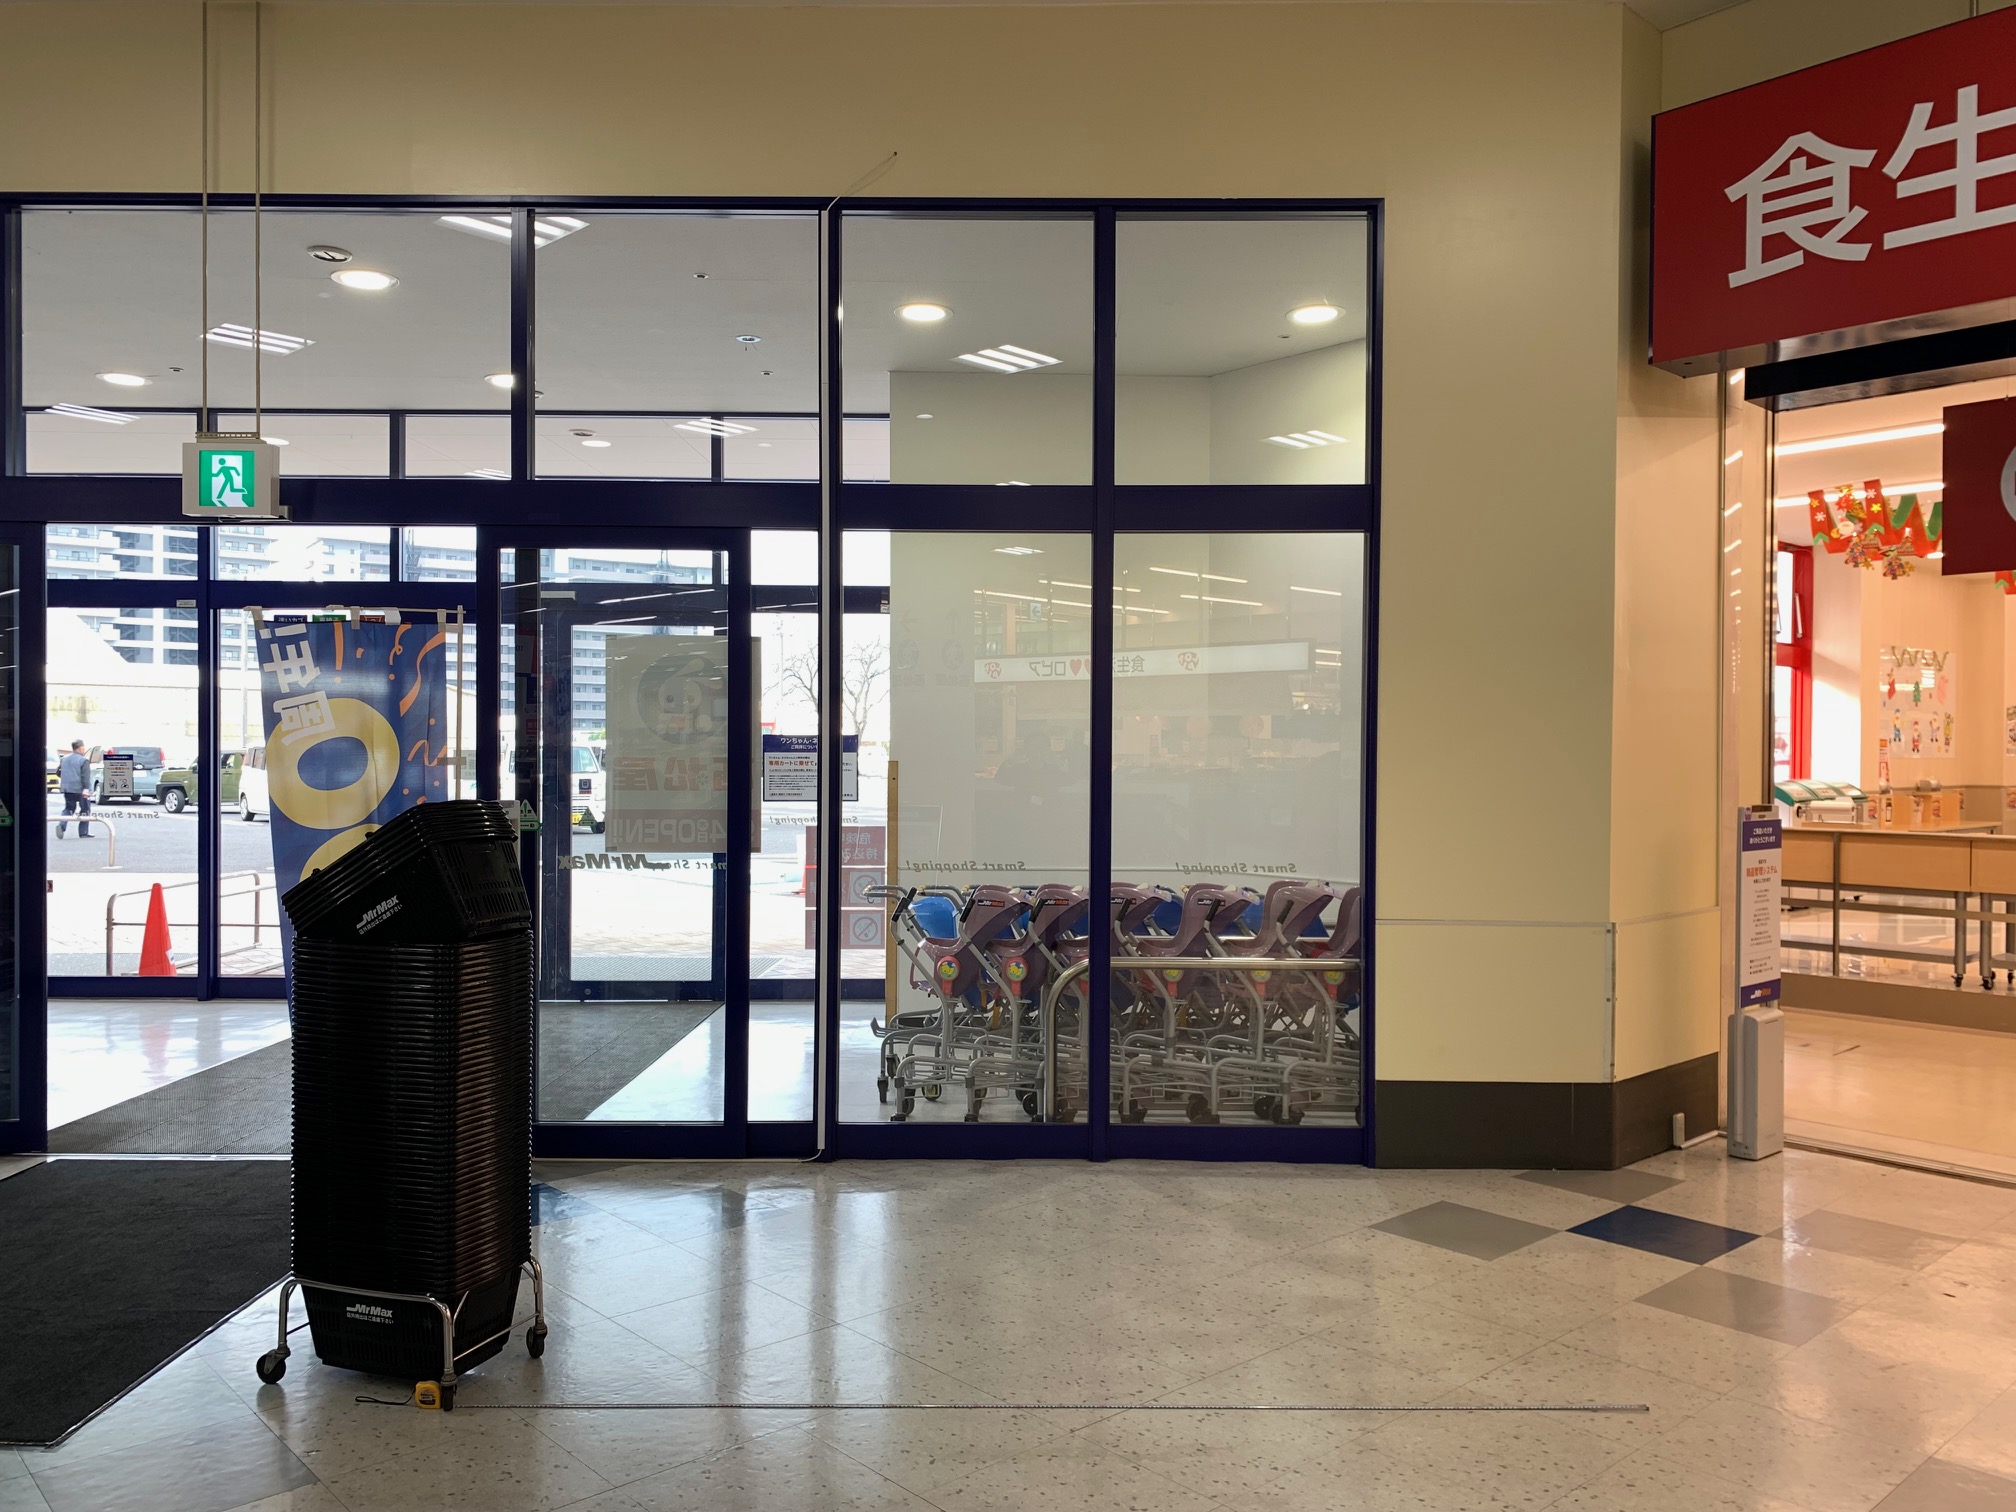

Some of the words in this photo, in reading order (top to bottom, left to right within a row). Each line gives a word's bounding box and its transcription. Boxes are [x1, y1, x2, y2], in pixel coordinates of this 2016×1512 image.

[1724, 84, 2016, 289] 食生
[356, 894, 400, 930] MrMax
[346, 1303, 393, 1318] MrMax
